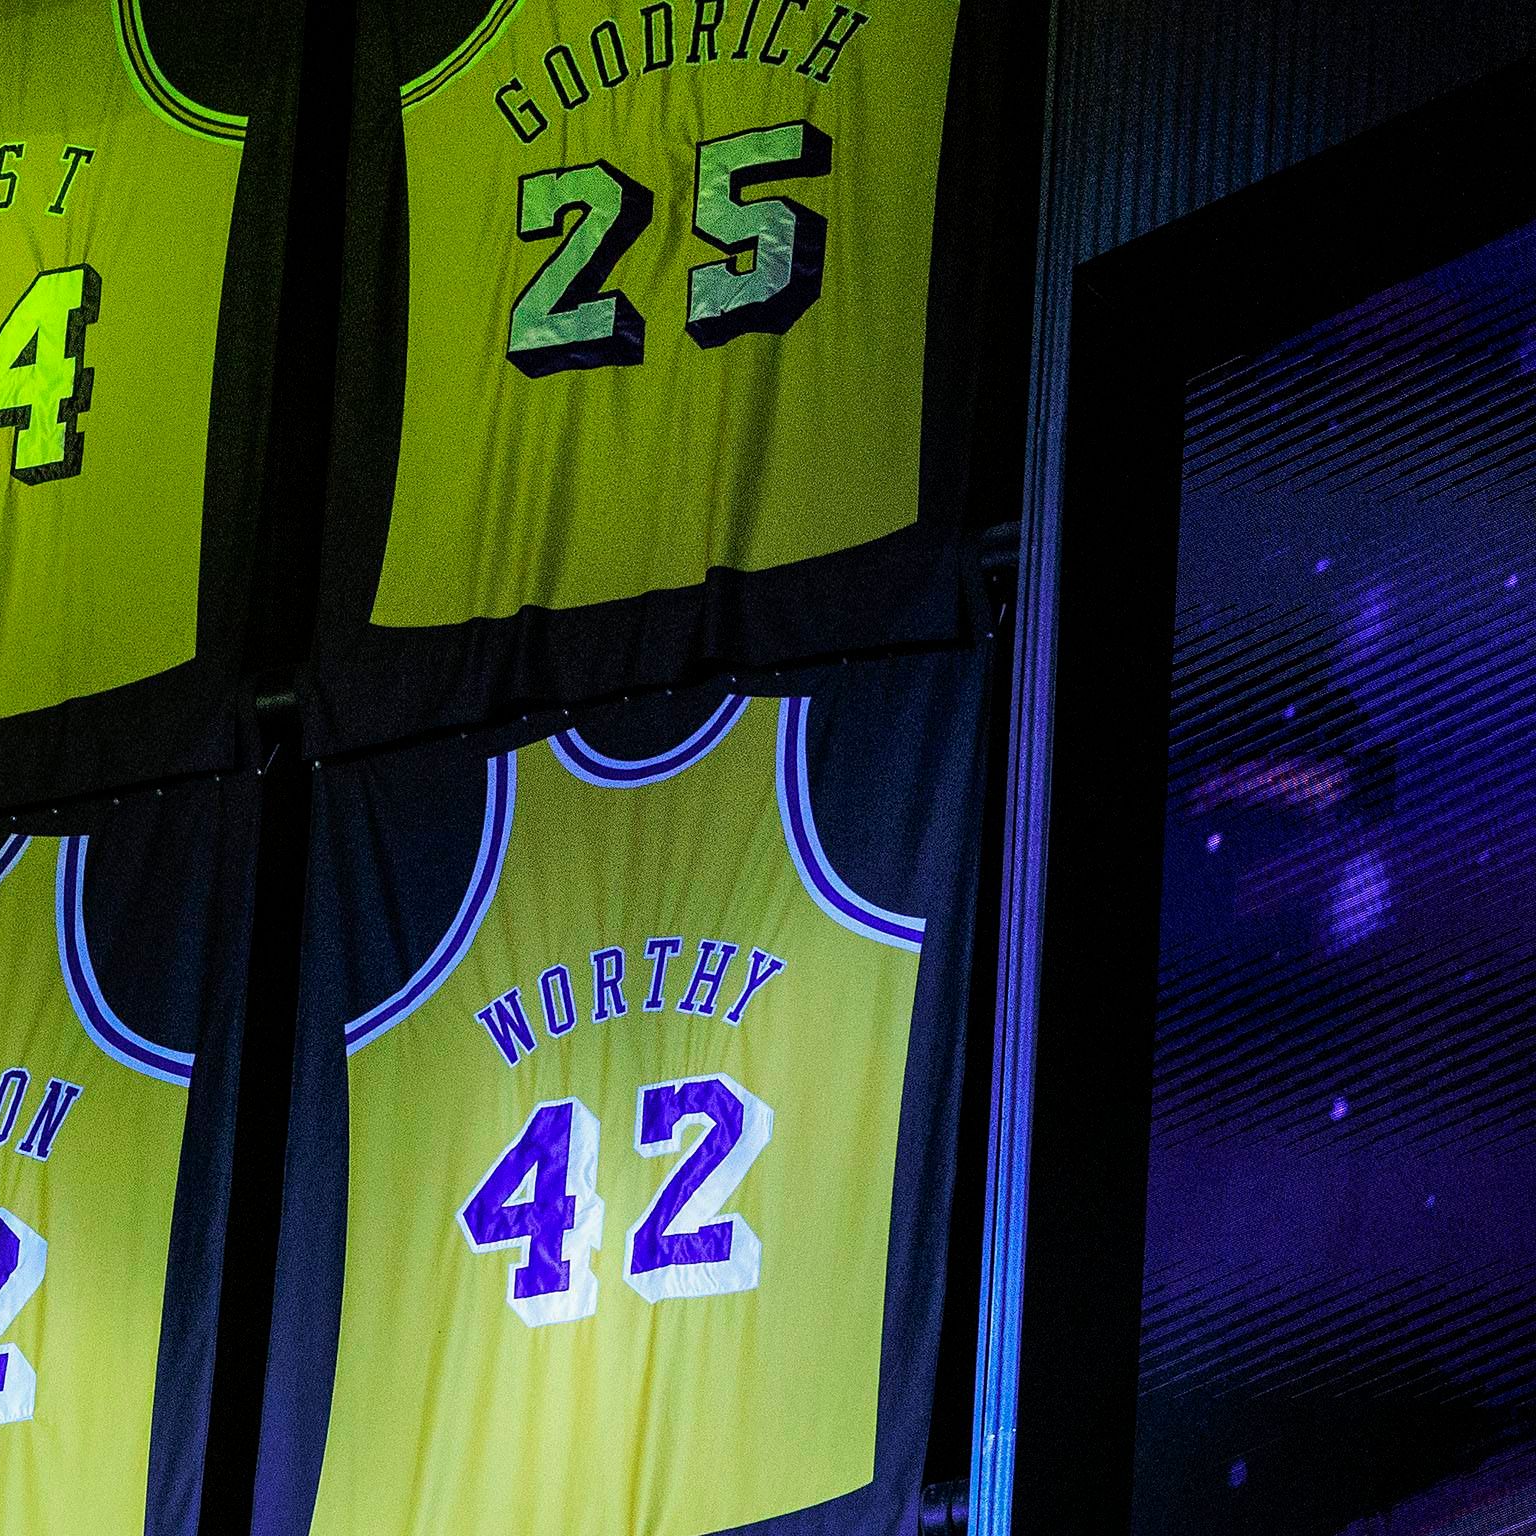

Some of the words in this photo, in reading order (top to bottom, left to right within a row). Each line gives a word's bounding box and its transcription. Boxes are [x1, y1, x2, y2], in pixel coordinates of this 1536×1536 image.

[495, 0, 868, 144] GOODRICH
[506, 119, 832, 378] 25
[473, 936, 787, 1067] WORTHY
[455, 1072, 774, 1329] 42
